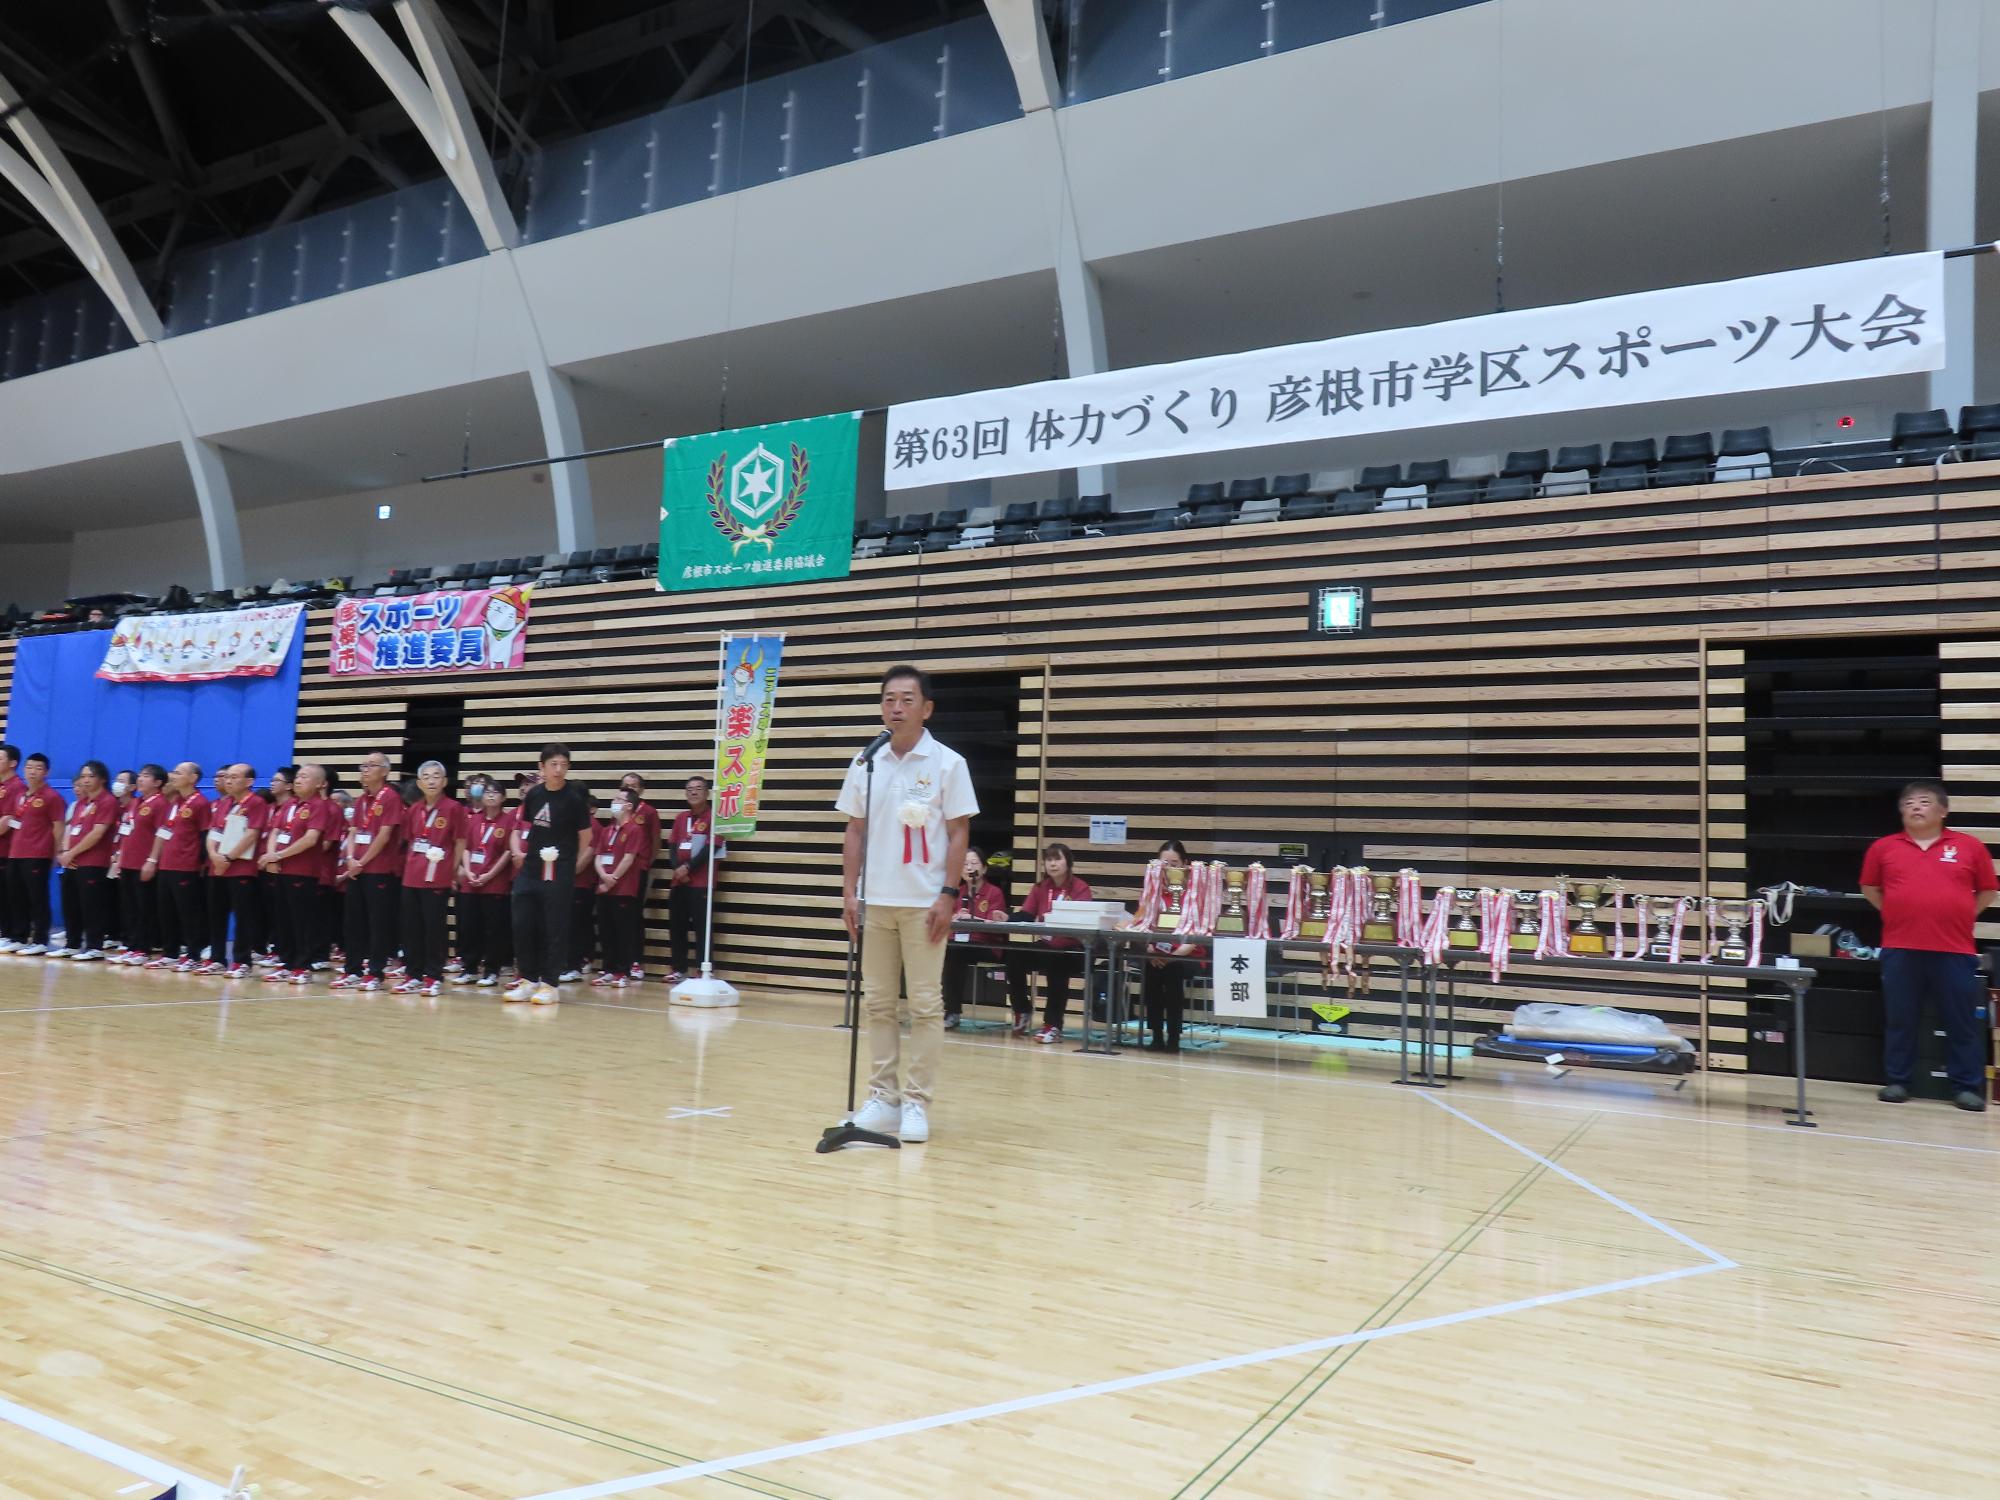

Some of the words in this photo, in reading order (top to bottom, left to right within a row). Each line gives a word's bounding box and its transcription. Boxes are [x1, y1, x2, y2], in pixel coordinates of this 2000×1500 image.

[892, 415, 1010, 470] 第63回
[1025, 384, 1238, 453] 体力づくり
[1265, 292, 1928, 424] 彦根市学区スポーツ大会
[337, 602, 358, 672] 彦根市
[359, 596, 462, 634] スポーツ
[373, 626, 486, 669] 推進委員
[716, 703, 754, 819] 楽スポ
[1230, 953, 1250, 1003] 本部
